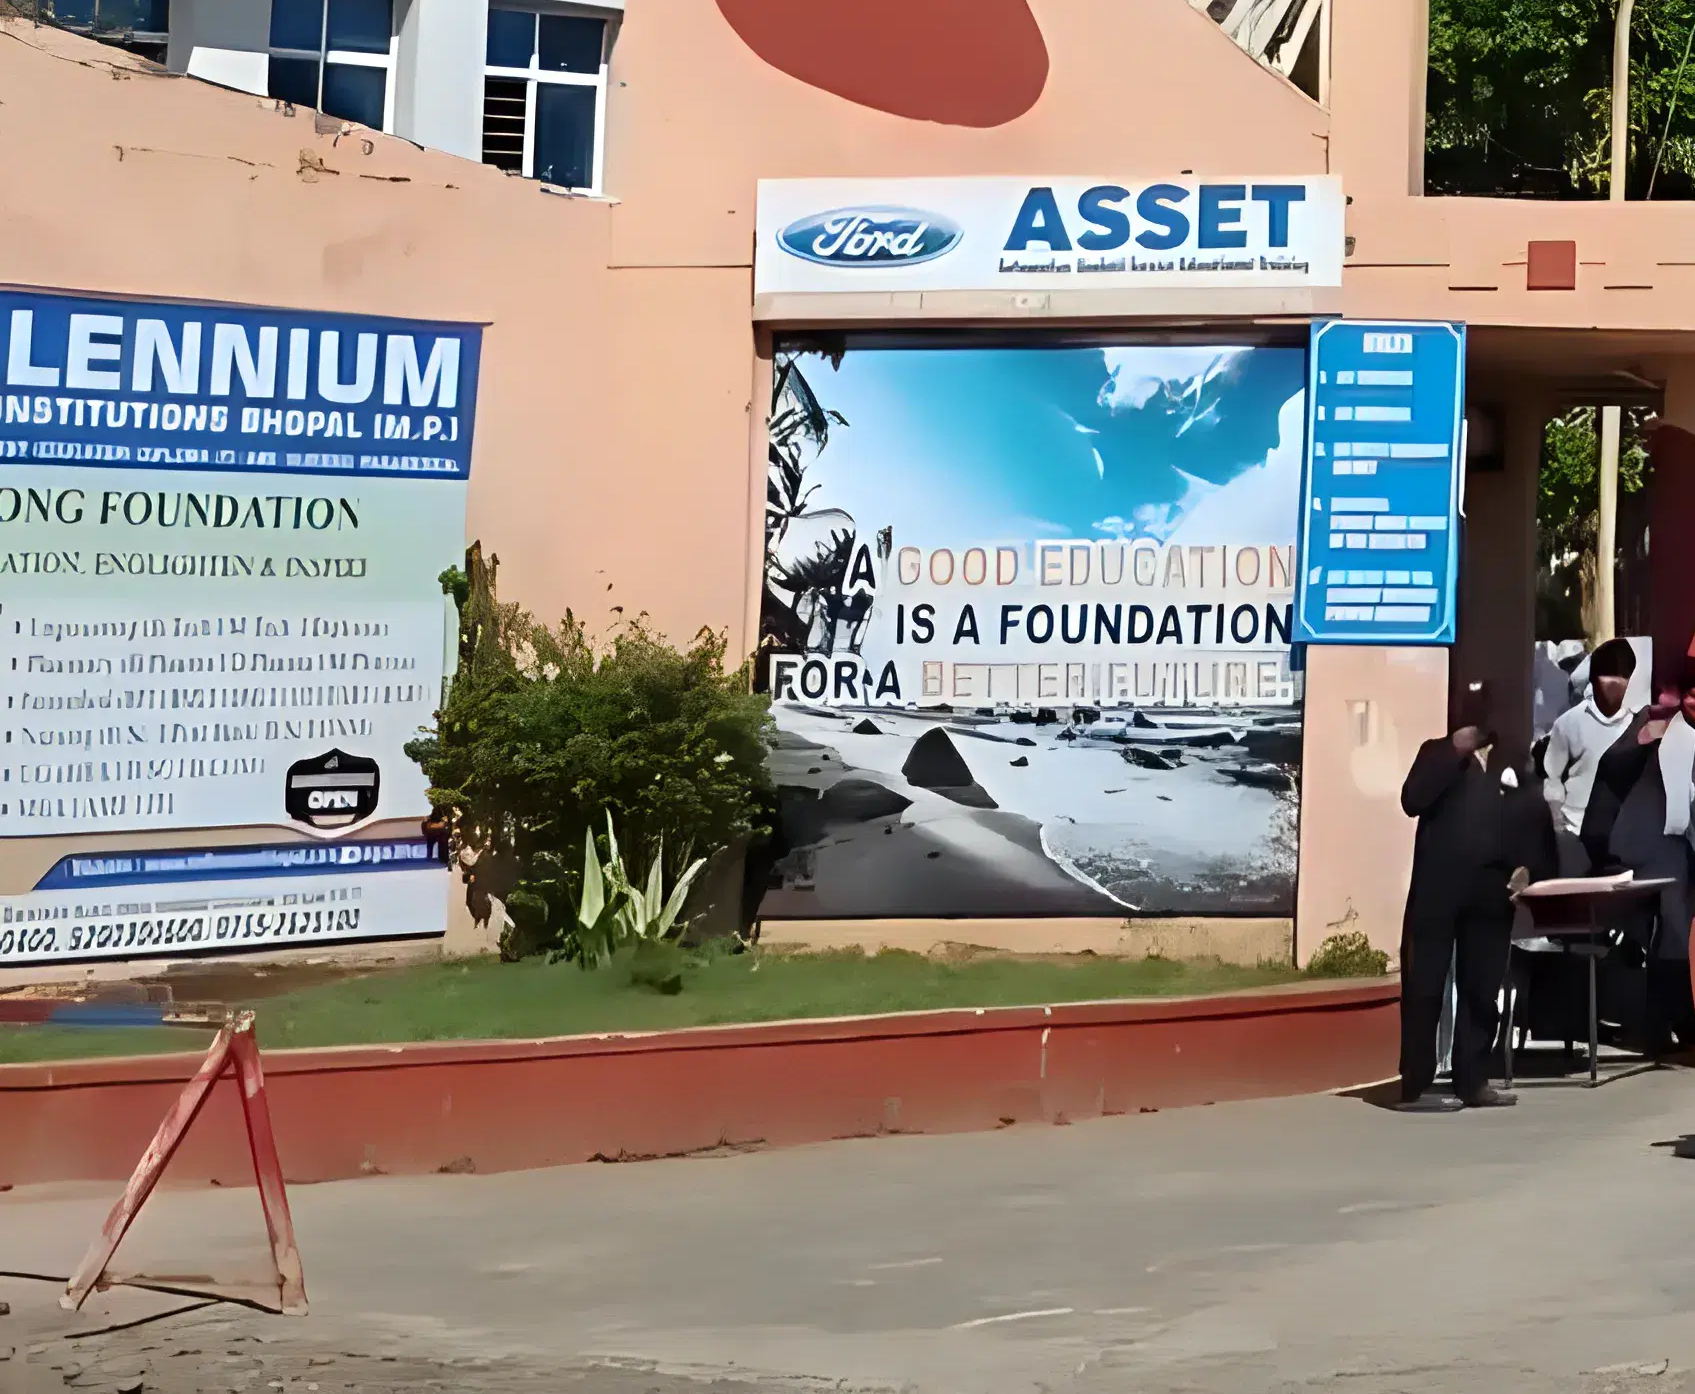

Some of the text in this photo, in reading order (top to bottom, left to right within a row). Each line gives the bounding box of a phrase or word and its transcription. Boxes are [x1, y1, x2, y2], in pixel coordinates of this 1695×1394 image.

[812, 213, 929, 258] Ford
[1002, 183, 1306, 251] ASSET
[7, 310, 460, 408] LENNIUM
[100, 491, 359, 532] FOUNDATION
[850, 543, 1294, 588] A GOOD EDUCATION
[896, 603, 1294, 645] IS A FOUNDATION
[775, 661, 864, 699] FOR
[875, 661, 901, 700] A
